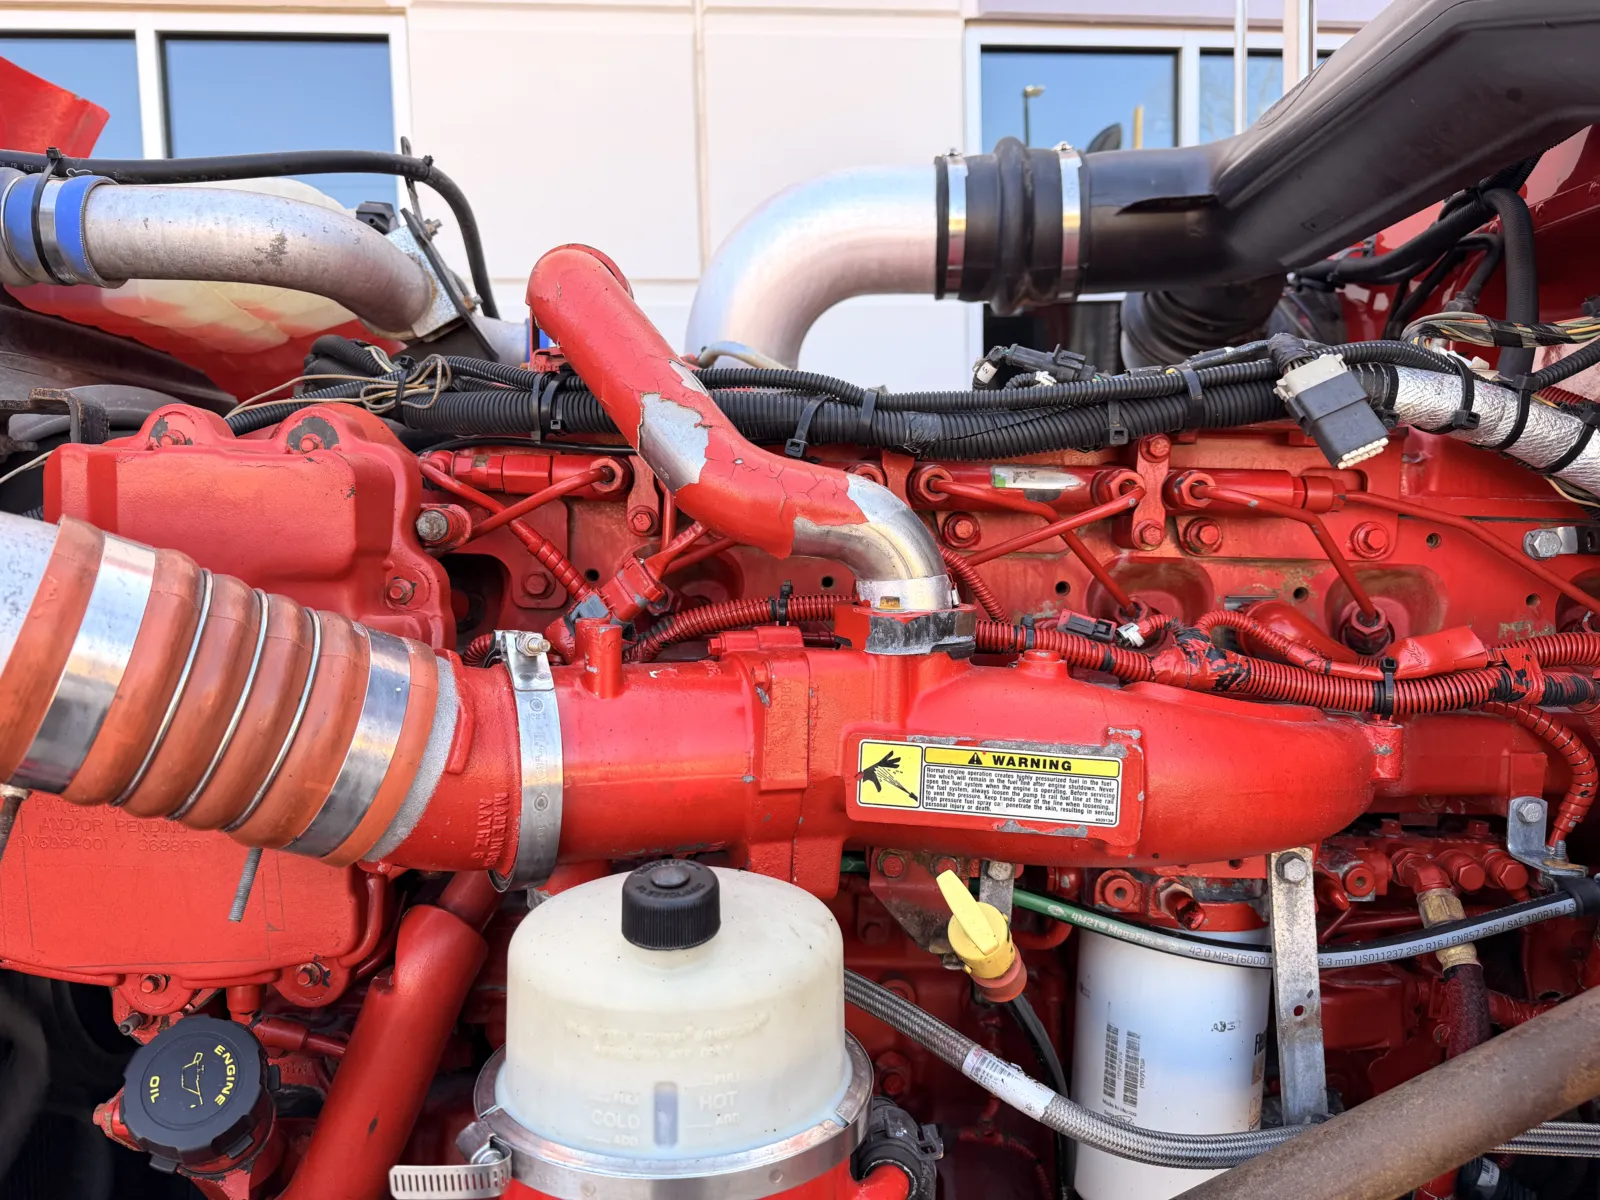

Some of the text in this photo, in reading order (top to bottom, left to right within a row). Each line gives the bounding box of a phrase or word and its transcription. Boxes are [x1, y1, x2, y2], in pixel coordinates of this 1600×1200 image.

[992, 755, 1072, 772] WARNING
[1016, 774, 1033, 782] highly
[1060, 806, 1084, 815] resulting
[1082, 802, 1110, 811] loosening.
[1406, 944, 1424, 956] 2SC
[1426, 940, 1443, 951] R16
[1452, 930, 1480, 945] EN857
[1482, 924, 1499, 935] 2SC
[1507, 917, 1525, 928] SAE
[1526, 907, 1560, 922] 100R16
[1188, 946, 1210, 958] 42.0
[1213, 950, 1234, 962] MPa
[214, 1045, 237, 1106] ENGINE
[149, 1075, 160, 1104] OIL
[699, 1090, 738, 1111] HOT
[592, 1109, 640, 1129] COLD
[612, 1134, 639, 1147] ADD
